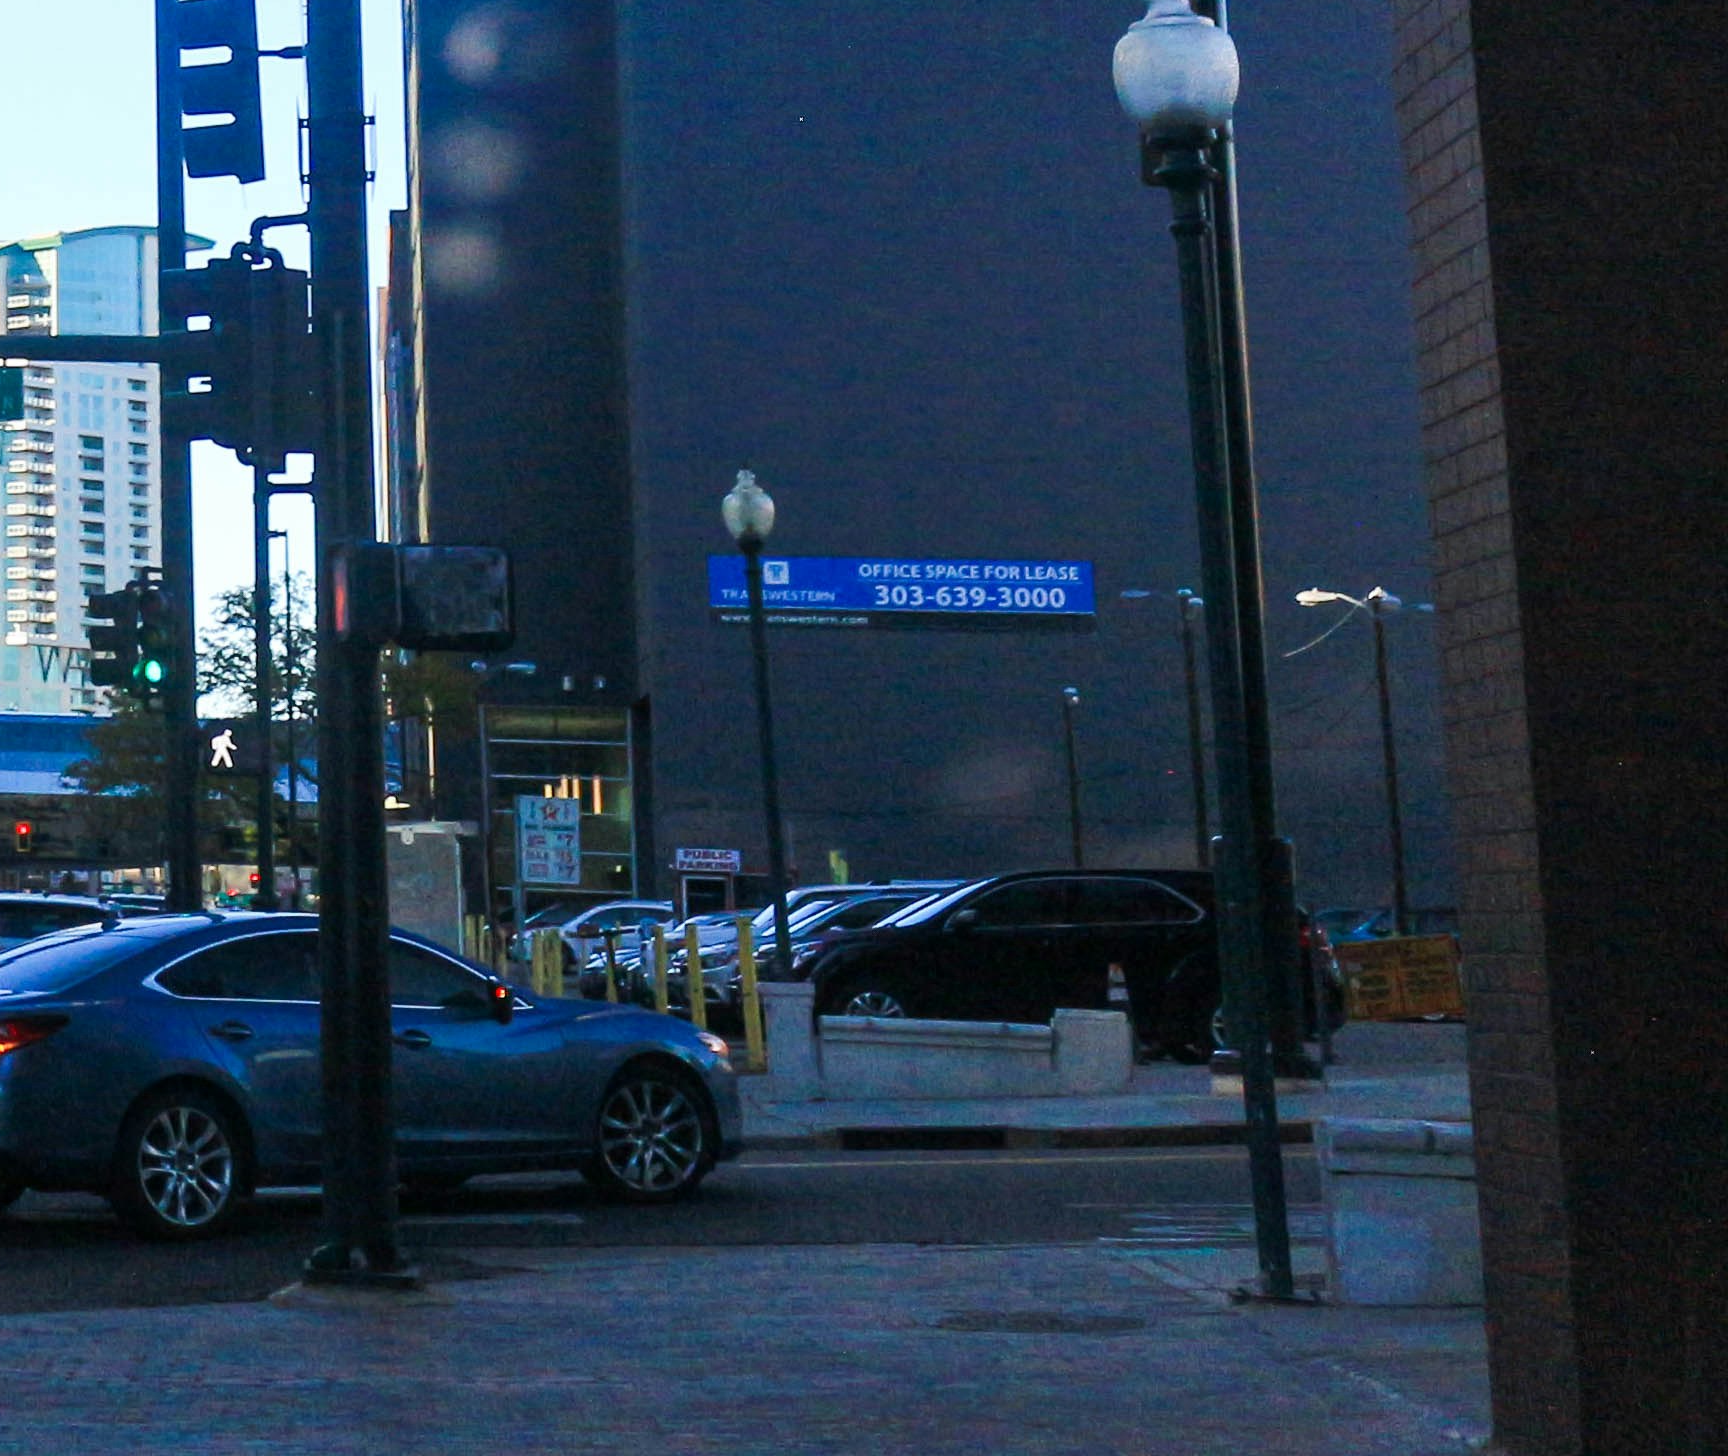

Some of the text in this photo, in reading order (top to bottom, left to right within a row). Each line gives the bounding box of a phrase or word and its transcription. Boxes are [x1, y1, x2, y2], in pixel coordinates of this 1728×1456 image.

[858, 563, 1080, 580] OFFICE SPACE FOR LEASE
[721, 588, 836, 602] TRASWESTERN
[874, 585, 1066, 608] 303-639-3000
[683, 850, 733, 860] PUBLIC
[678, 861, 737, 871] PARKING
